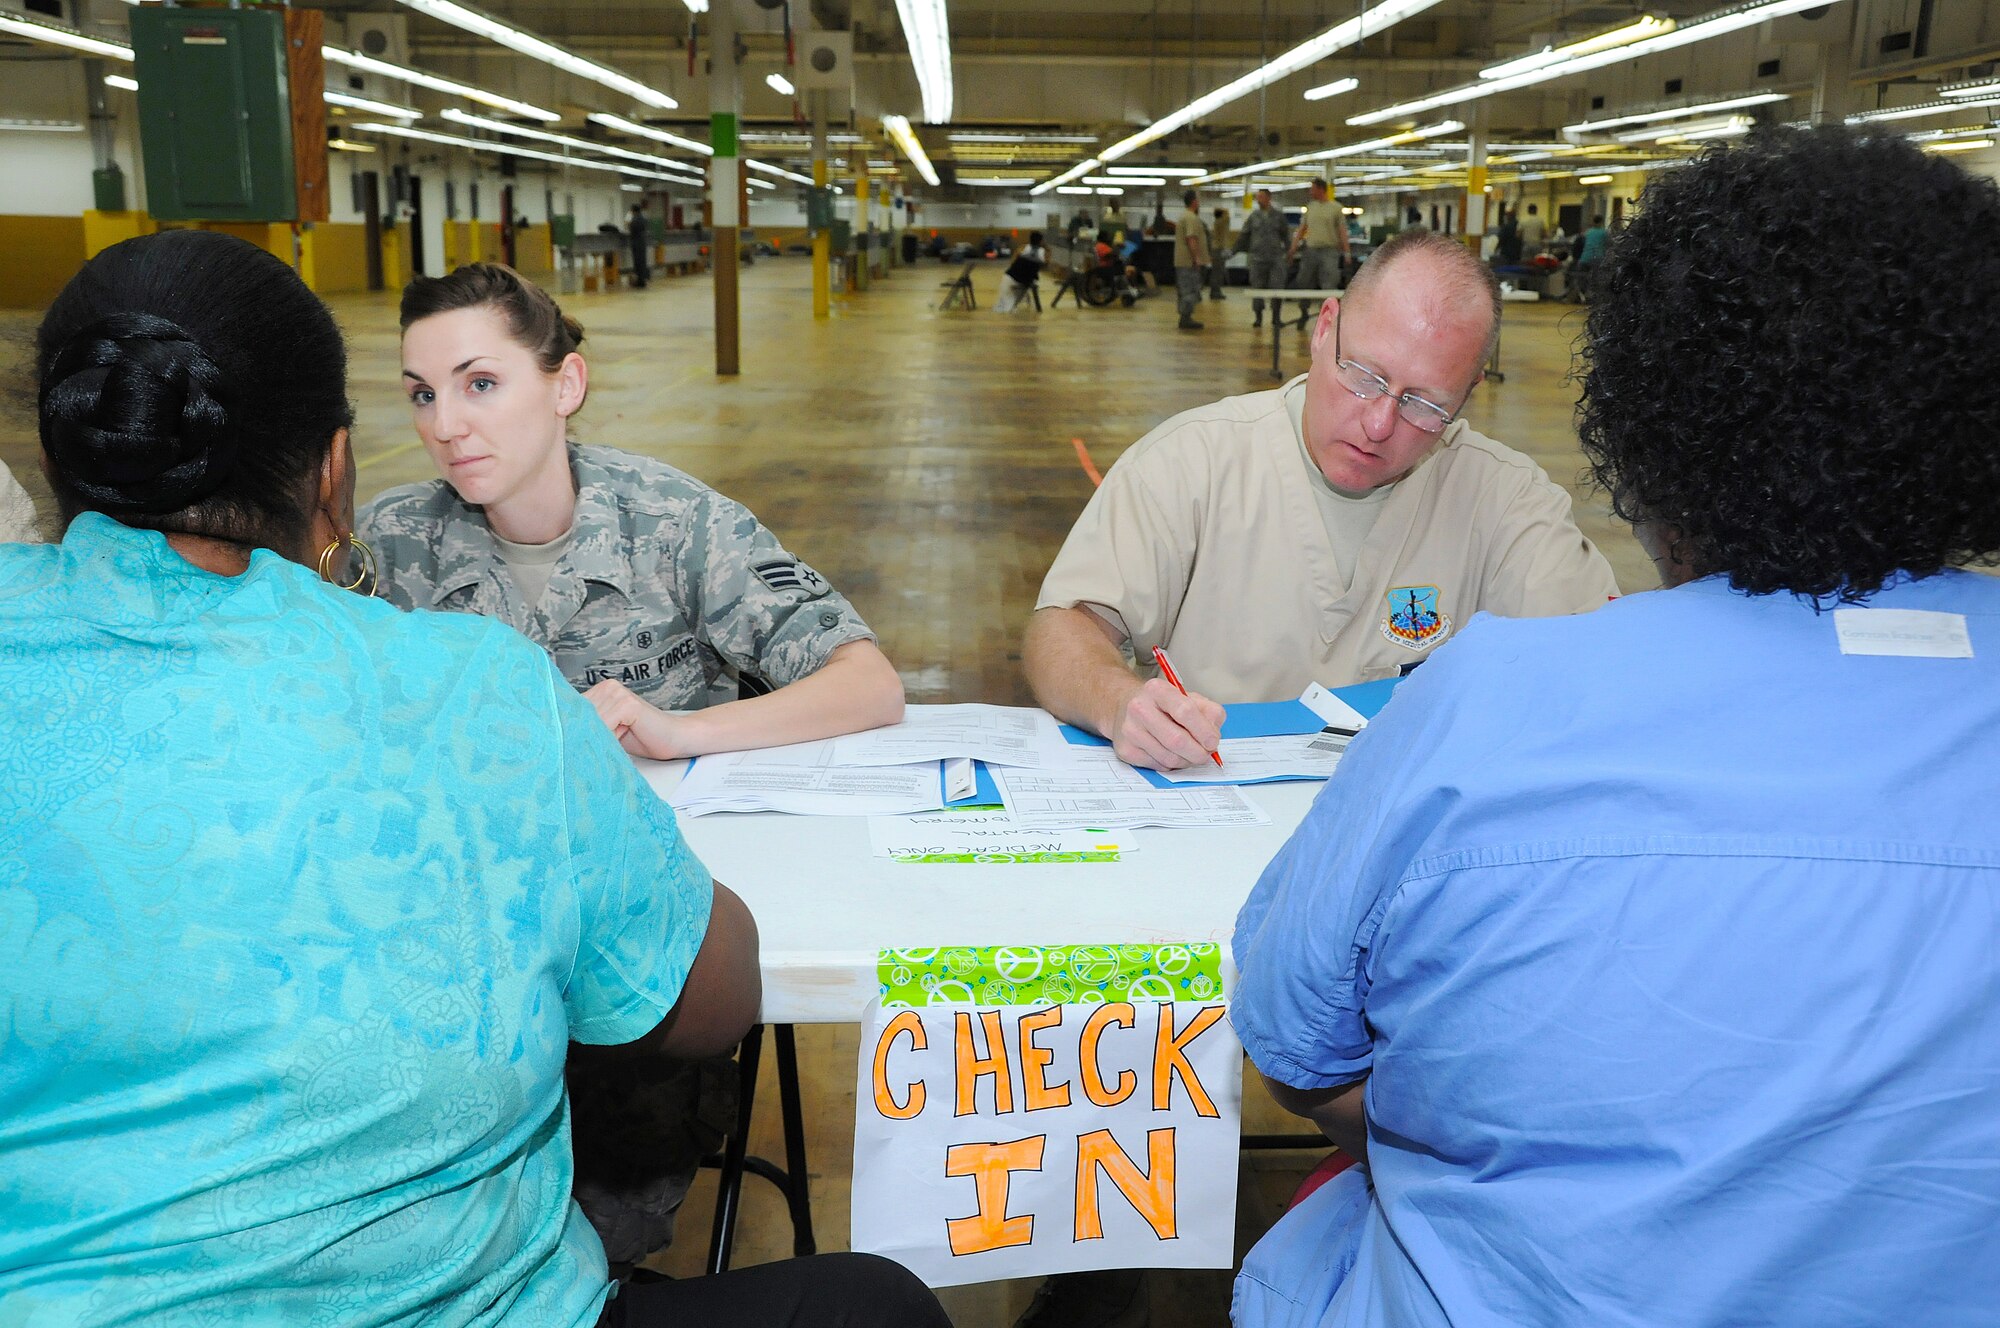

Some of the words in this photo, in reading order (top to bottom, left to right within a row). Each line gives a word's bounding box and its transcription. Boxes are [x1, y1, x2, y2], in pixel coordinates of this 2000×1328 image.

[1403, 639, 1428, 648] MEDICAL
[1430, 624, 1447, 642] GROUP
[622, 664, 650, 682] AIR
[658, 638, 695, 673] FORCE
[887, 846, 946, 855] ONLY
[957, 843, 1062, 853] MEDICAL
[872, 1002, 1226, 1119] CHECK
[945, 1127, 1179, 1256] IN
